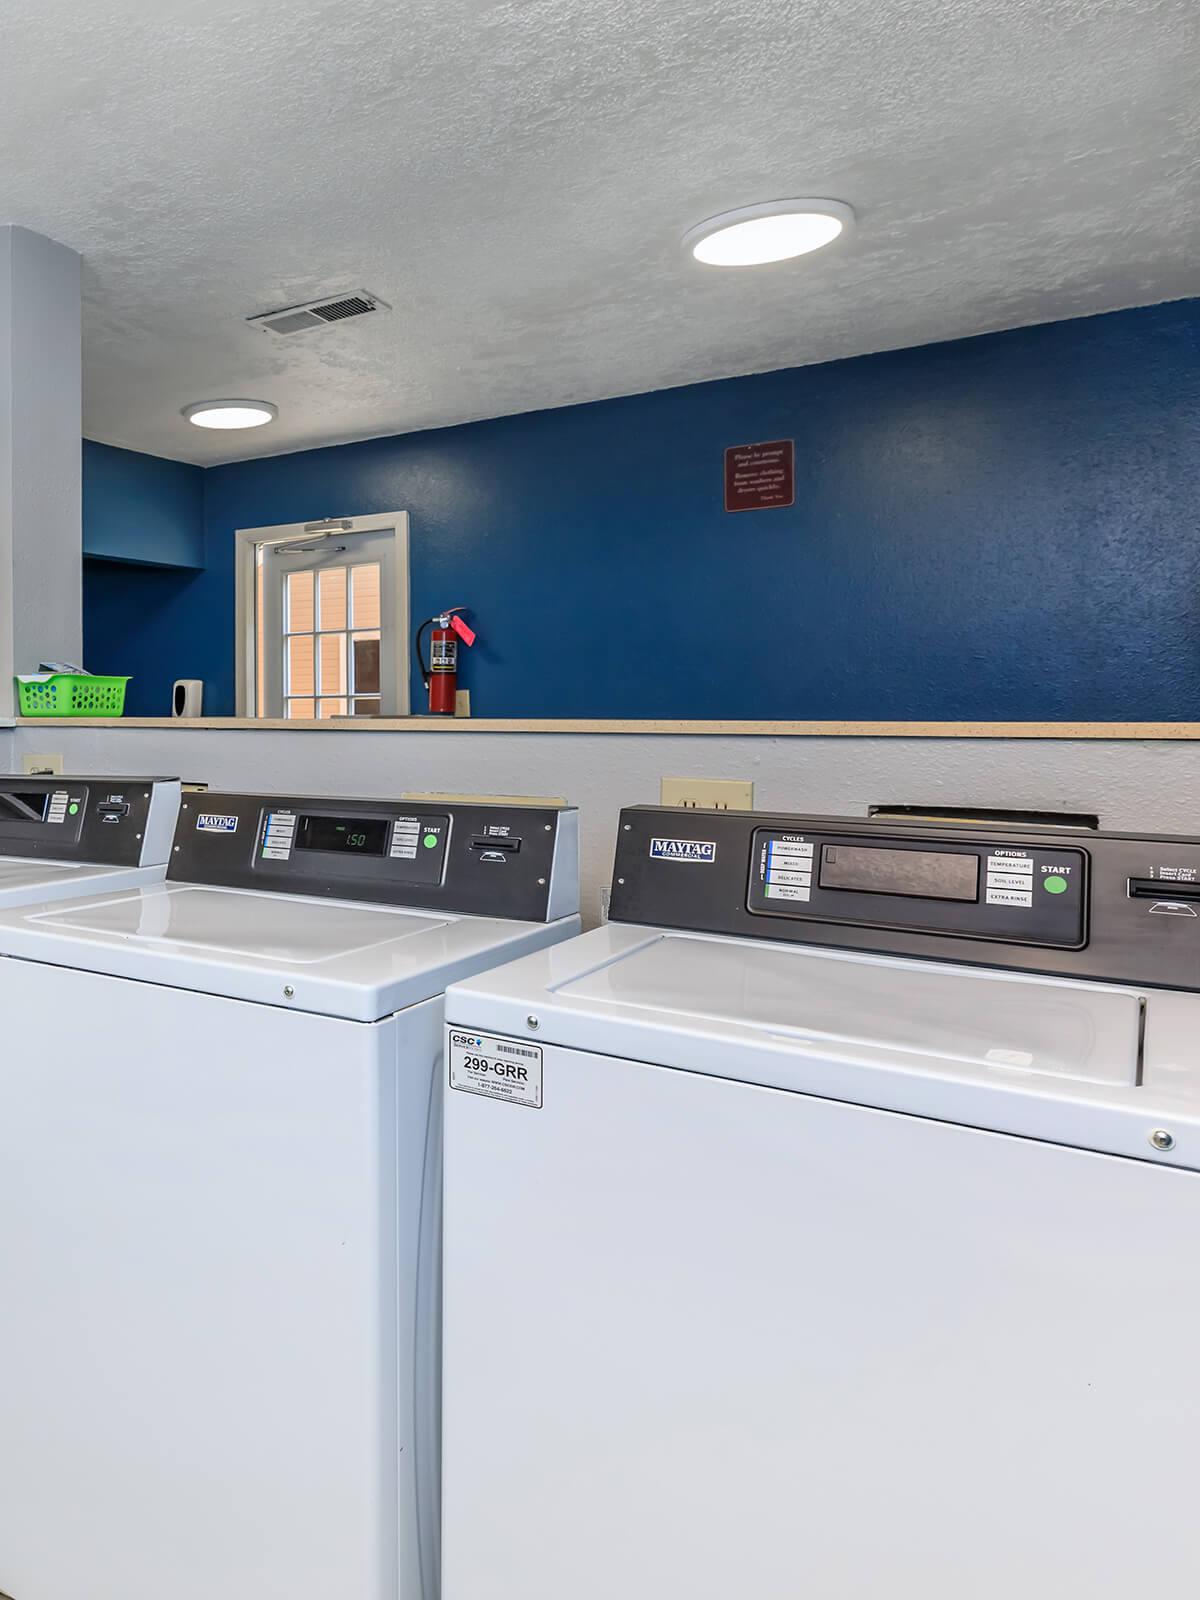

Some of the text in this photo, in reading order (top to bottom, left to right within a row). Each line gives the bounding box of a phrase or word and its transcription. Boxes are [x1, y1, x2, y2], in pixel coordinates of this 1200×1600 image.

[200, 816, 235, 827] MAYTAG
[654, 841, 713, 856] MAYTAG
[994, 850, 1027, 858] OPTIONS
[990, 861, 1031, 869] TEMPERATURE
[1040, 865, 1072, 875] START
[452, 1035, 475, 1045] CSC
[463, 1056, 529, 1082] 299-GRR
